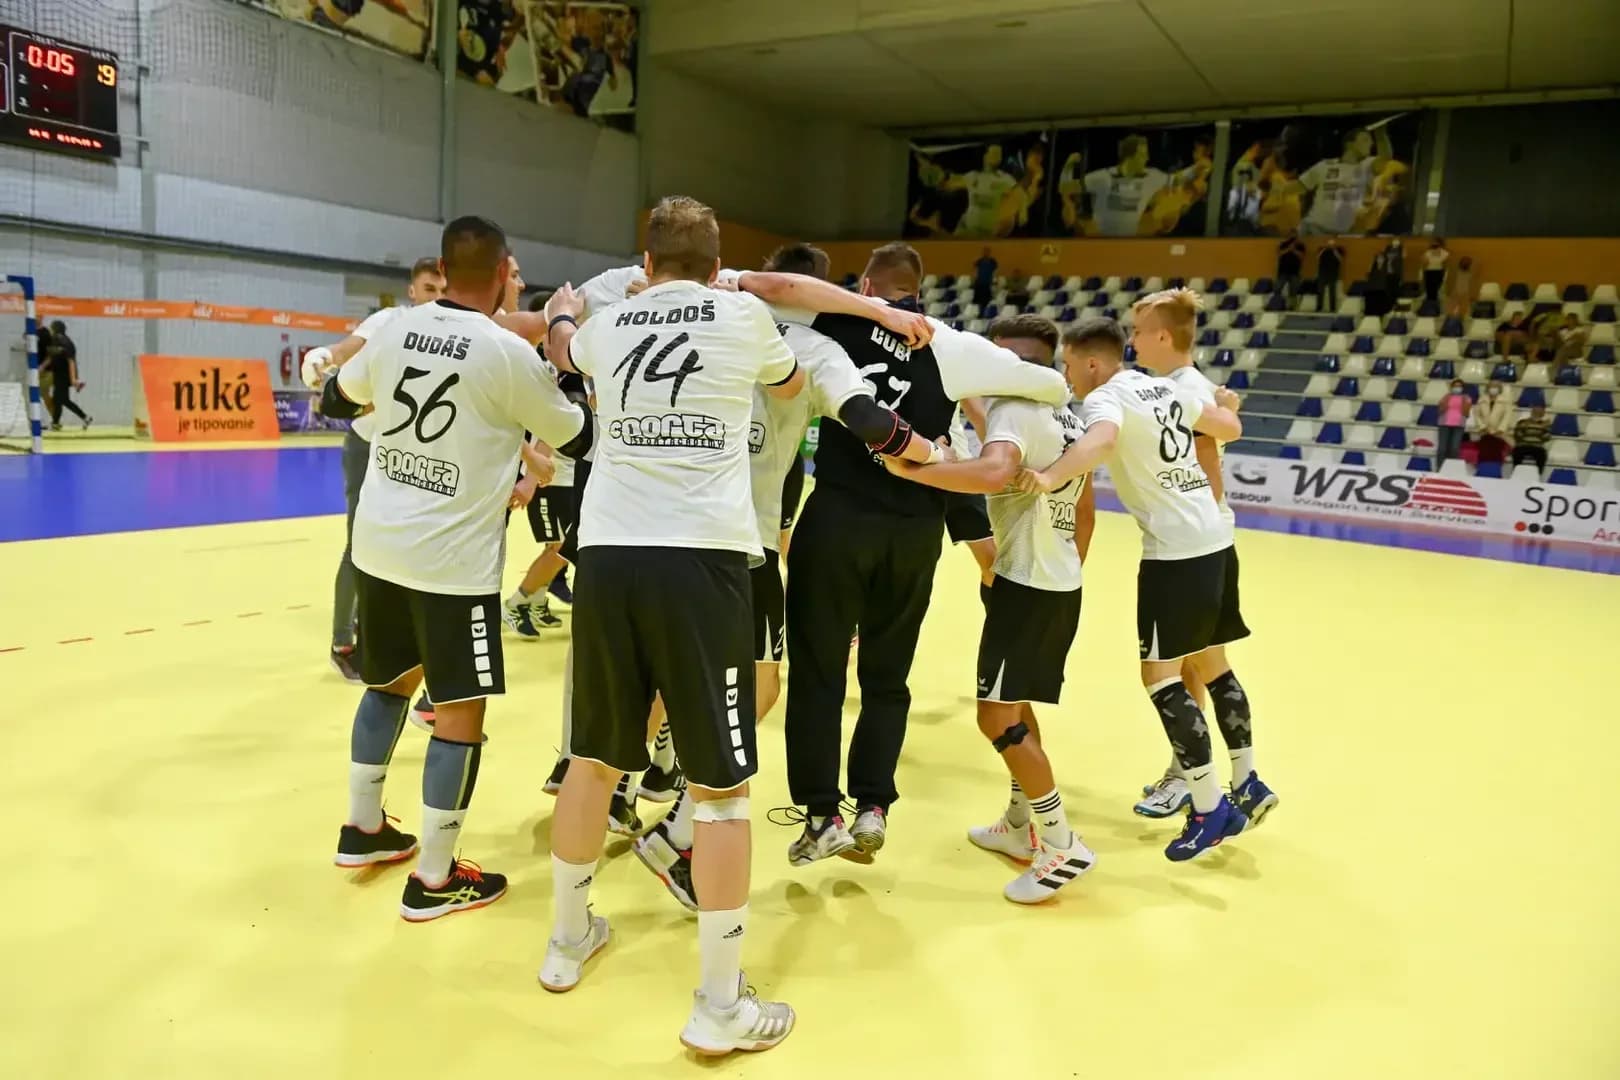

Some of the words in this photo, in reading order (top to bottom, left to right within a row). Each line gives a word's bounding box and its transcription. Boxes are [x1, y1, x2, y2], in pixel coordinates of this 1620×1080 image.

[615, 299, 716, 327] HOLDOŠ
[403, 332, 472, 361] DUDÁŠ
[172, 367, 251, 412] niké
[612, 331, 704, 412] 14
[381, 366, 460, 444] 56
[1153, 400, 1192, 463] 83
[1289, 464, 1418, 507] WRS
[1520, 486, 1620, 522] Spor
